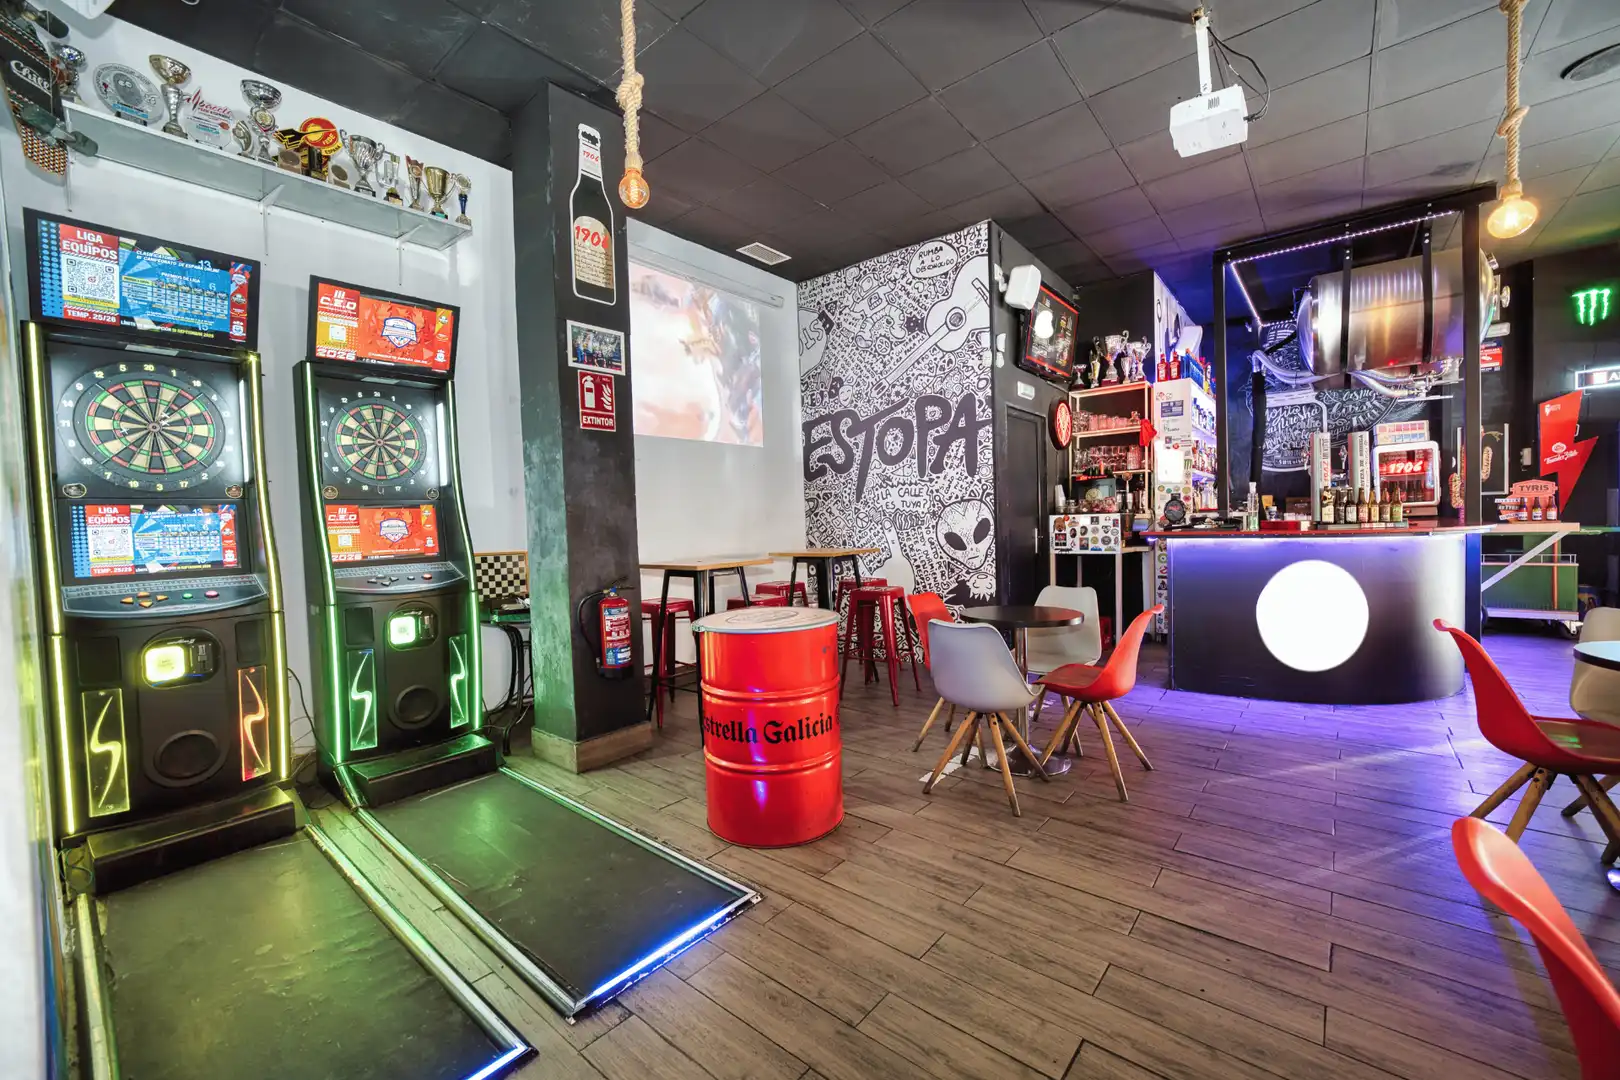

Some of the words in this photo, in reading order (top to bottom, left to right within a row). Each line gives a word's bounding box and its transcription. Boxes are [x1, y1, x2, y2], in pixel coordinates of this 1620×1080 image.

[583, 150, 599, 162] 1906
[77, 230, 104, 244] LIGA
[575, 226, 609, 249] 1906
[62, 240, 118, 260] EQUIPOS
[919, 246, 943, 260] RUMBA
[916, 259, 955, 273] DESCONOCIDO
[316, 349, 356, 361] 2026
[582, 415, 613, 427] EXTINTOR
[802, 392, 992, 502] ESTOPA
[1389, 461, 1423, 473] 1906
[898, 488, 924, 497] CALLE
[885, 501, 896, 510] ES
[901, 499, 927, 509] TUYA?
[88, 516, 131, 524] EQUIPOS
[854, 530, 870, 544] SACO
[908, 528, 920, 546] ESTE
[915, 526, 928, 548] ESTOY
[906, 544, 919, 564] DEJA
[925, 536, 941, 560] GRITO
[913, 548, 932, 582] SILENCIO
[920, 550, 943, 593] DURMIENDO
[763, 713, 833, 744] Galicia
